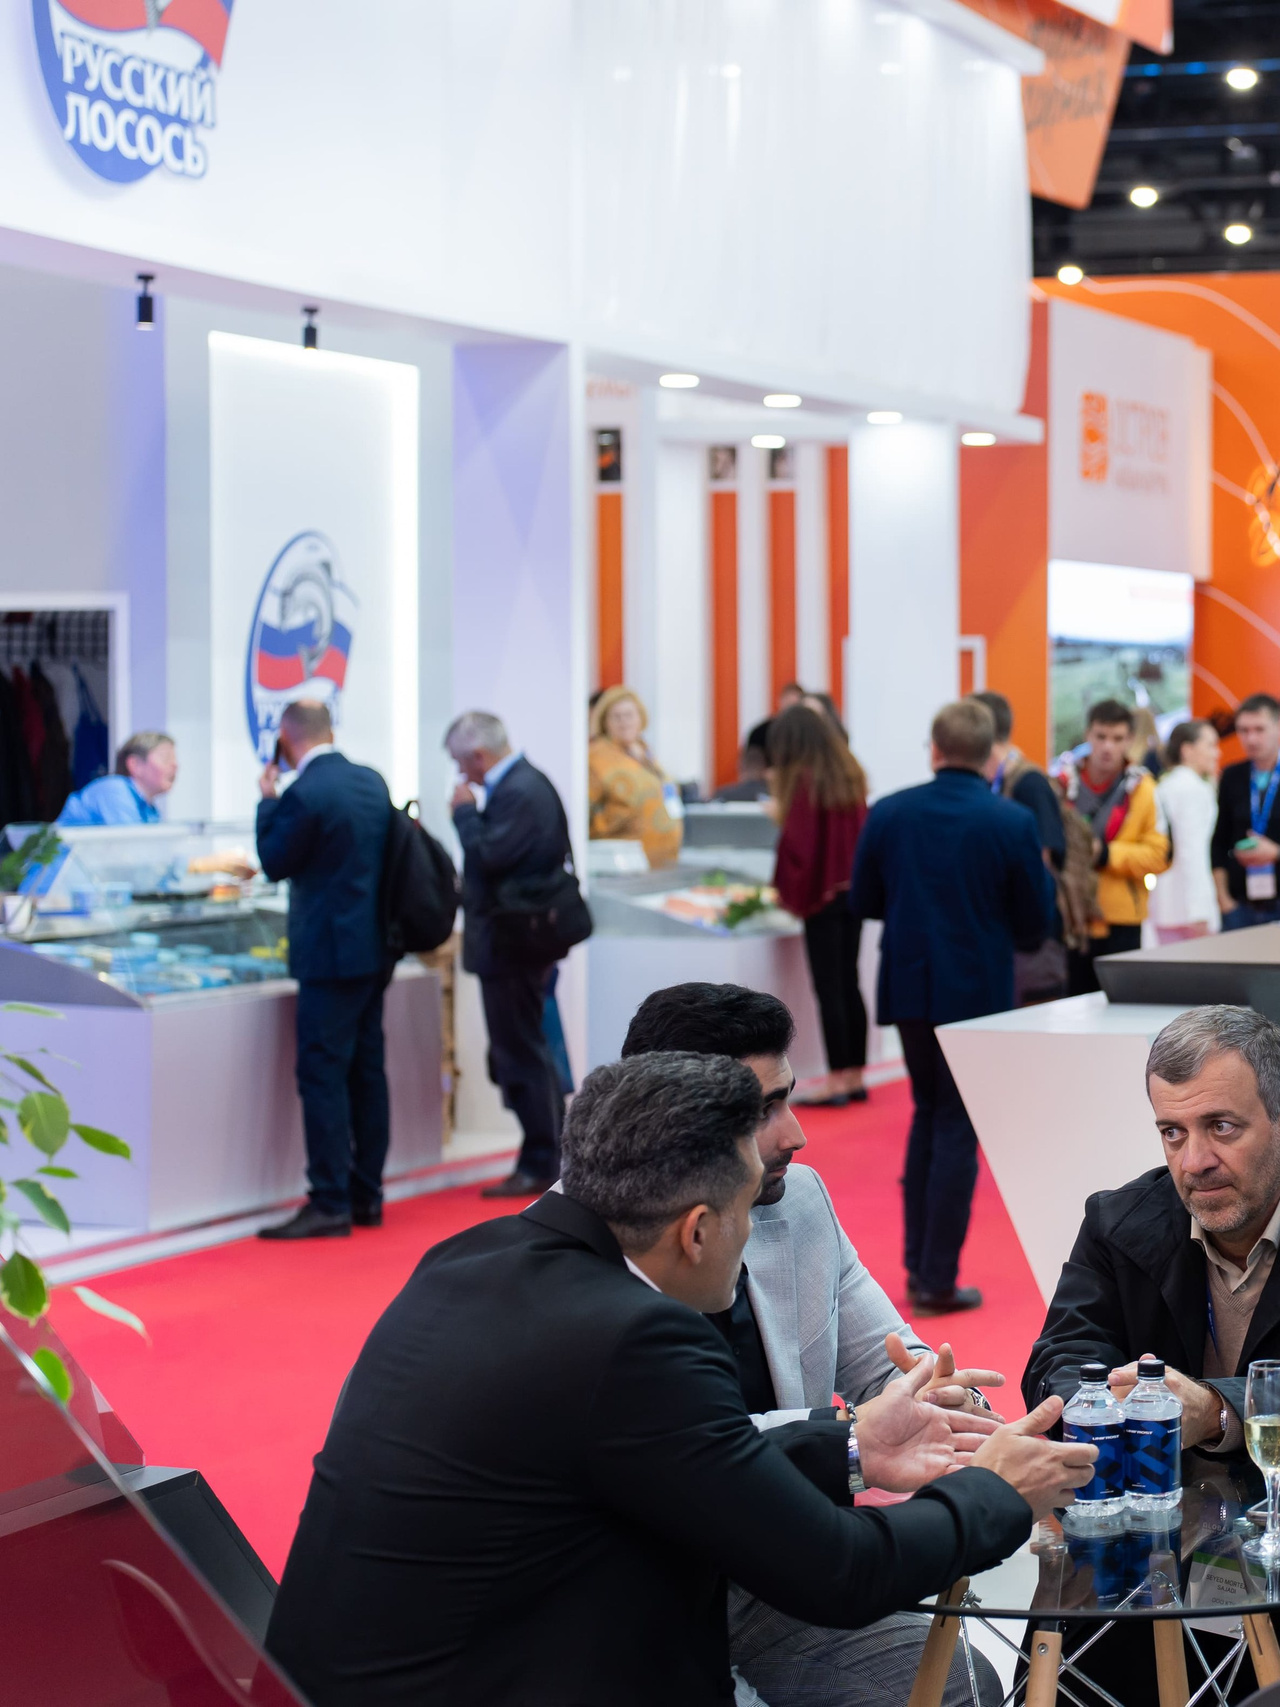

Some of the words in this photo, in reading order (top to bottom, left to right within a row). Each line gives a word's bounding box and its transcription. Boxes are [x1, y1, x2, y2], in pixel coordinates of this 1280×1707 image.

[61, 32, 216, 129] РУССКИЙ
[64, 91, 208, 180] ЛОСОСЬ
[1206, 1573, 1224, 1584] SEYED
[1217, 1584, 1236, 1594] SAJADI
